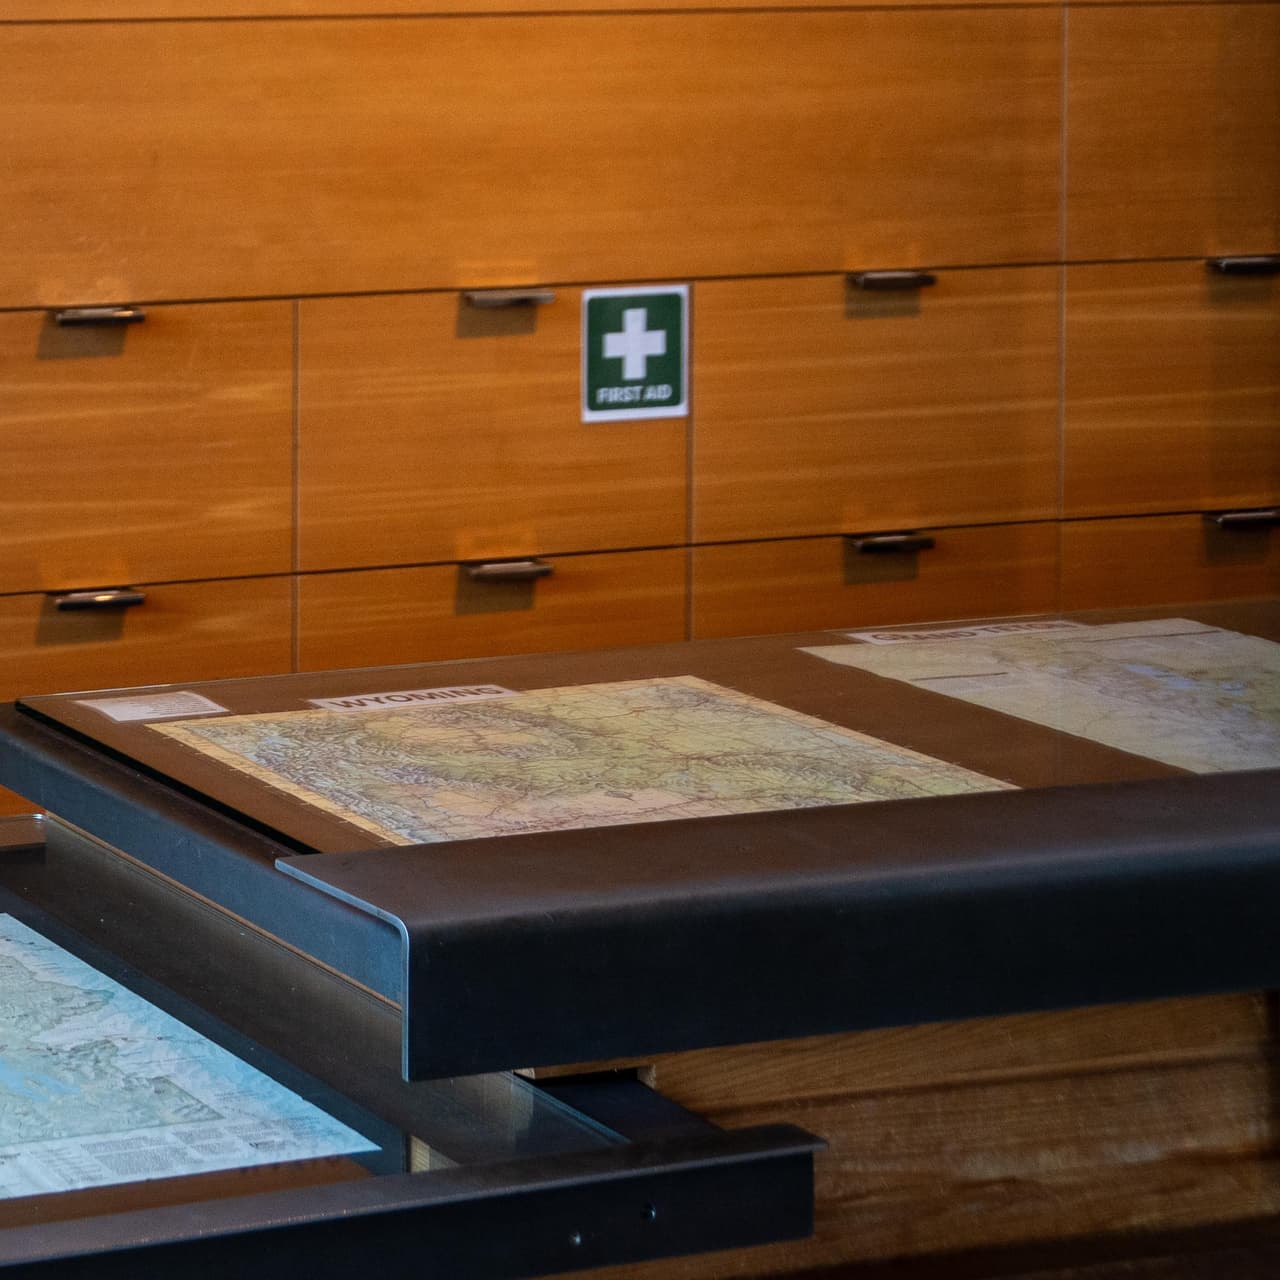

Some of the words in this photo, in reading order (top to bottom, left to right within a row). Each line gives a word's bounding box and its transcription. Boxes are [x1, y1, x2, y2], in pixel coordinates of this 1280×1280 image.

[596, 385, 643, 404] FIRST
[644, 383, 673, 401] AID
[329, 686, 504, 708] WYOMING
